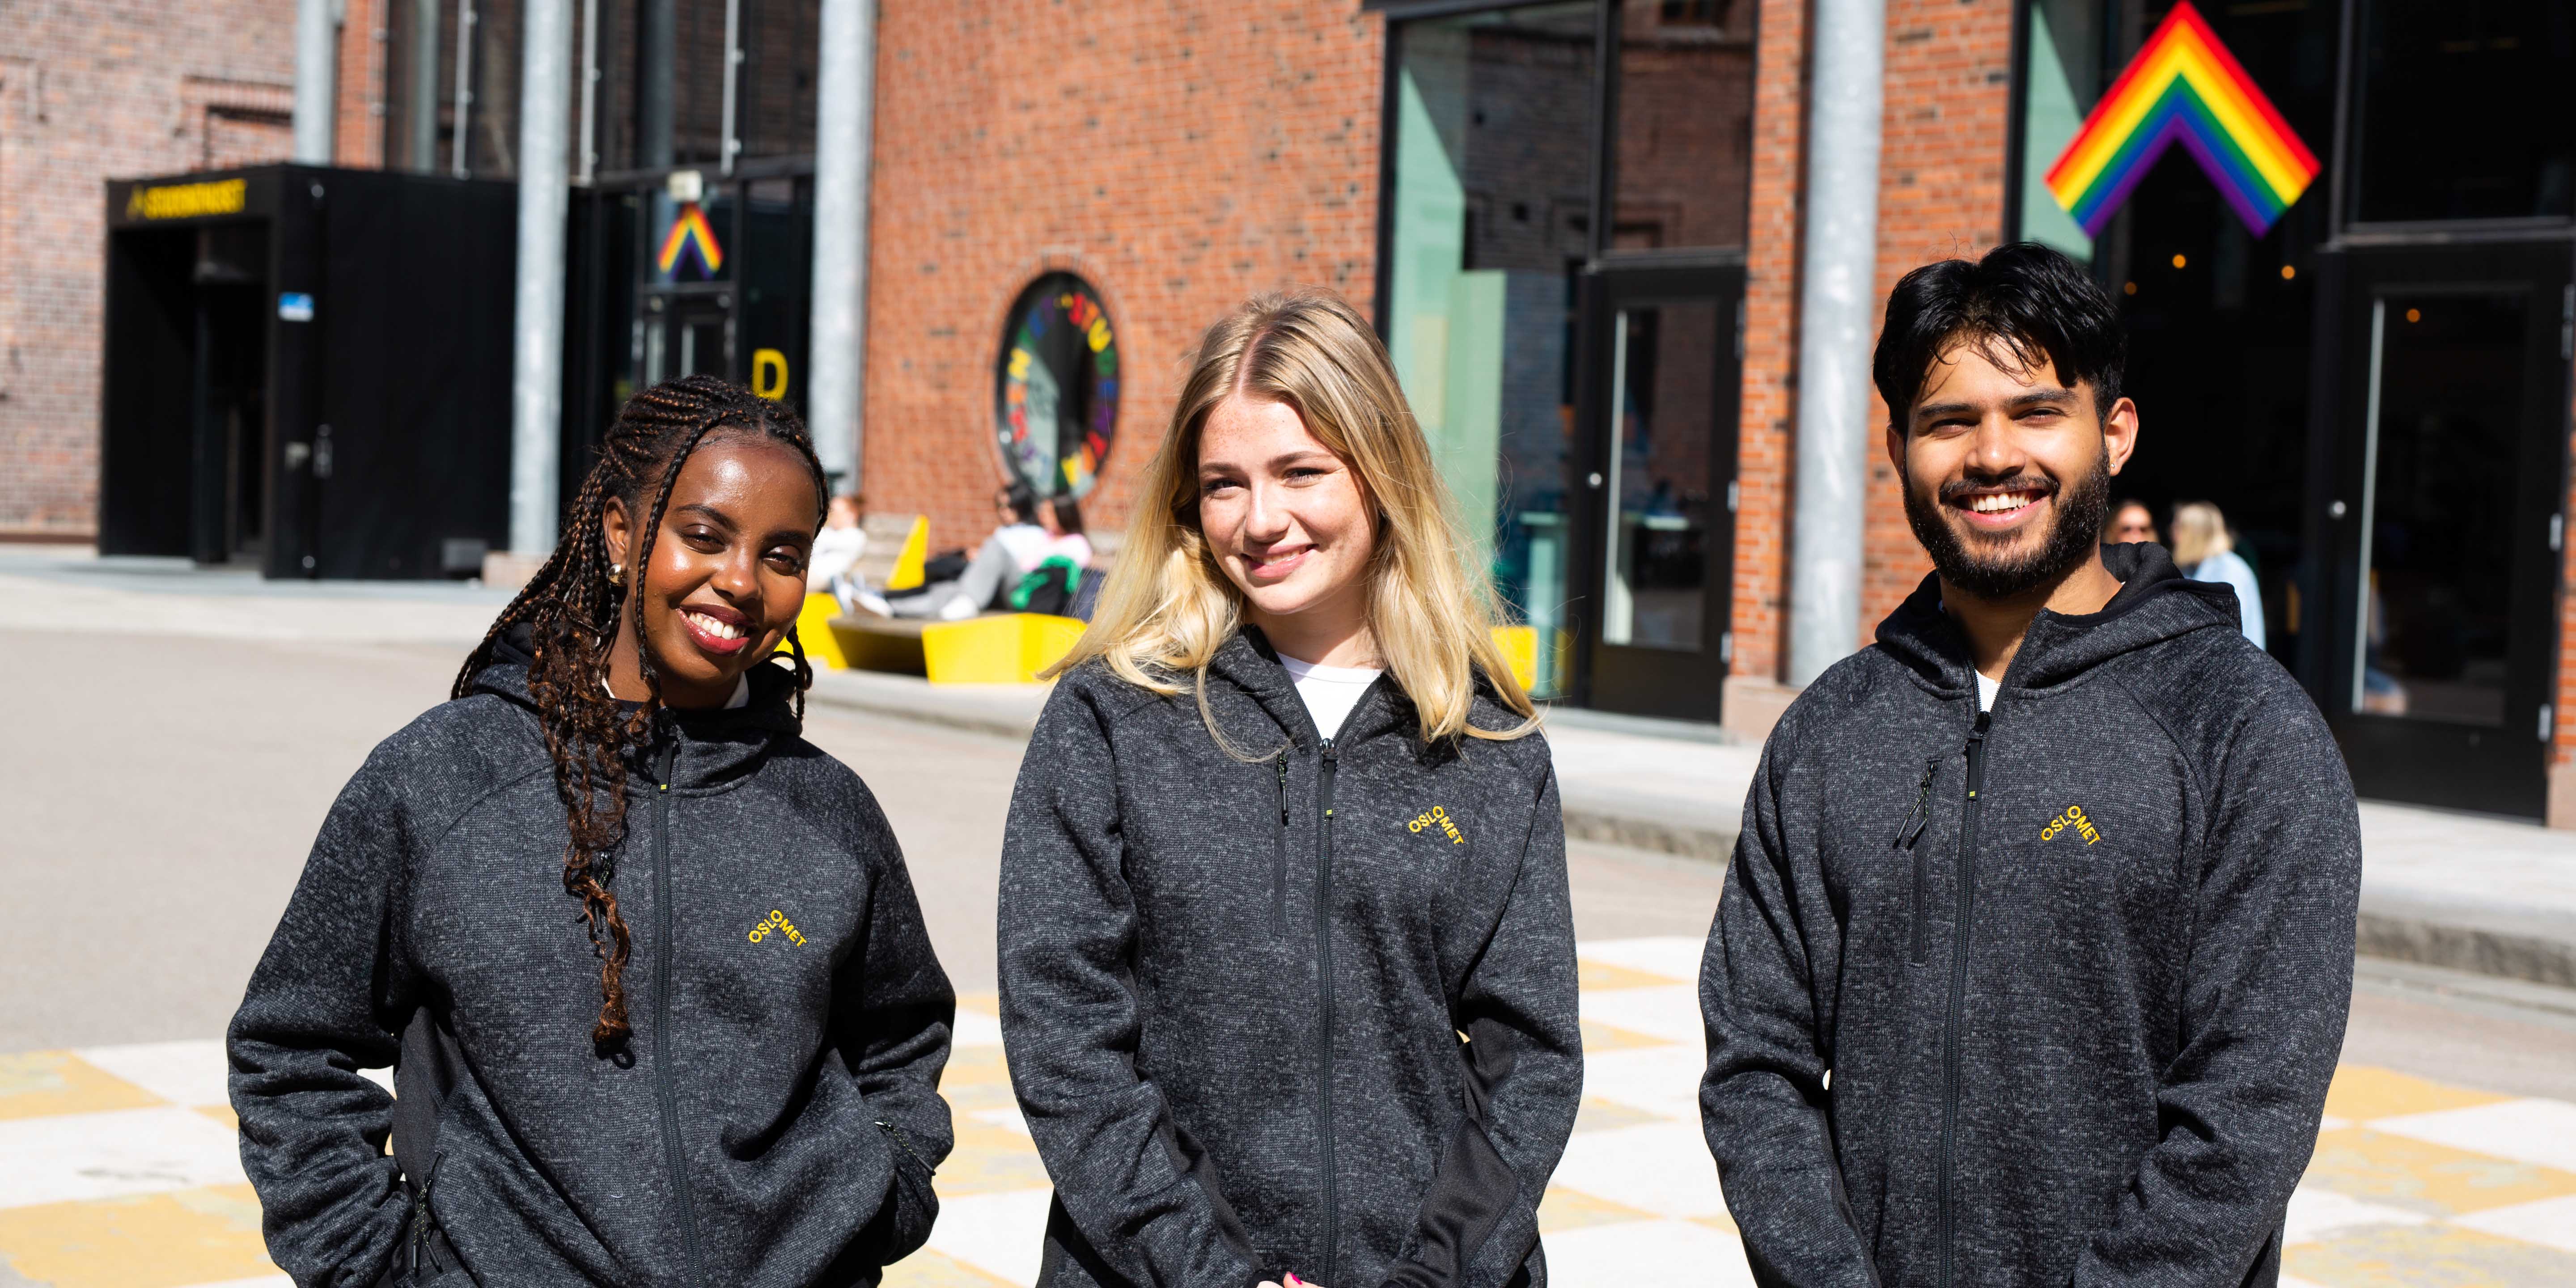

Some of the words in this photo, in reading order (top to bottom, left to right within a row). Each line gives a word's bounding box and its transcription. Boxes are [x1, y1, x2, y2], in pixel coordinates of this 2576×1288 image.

[1408, 805, 1464, 845] OSLOMET
[2041, 805, 2100, 845] OSLOMET
[748, 910, 807, 947] OSLOMET
